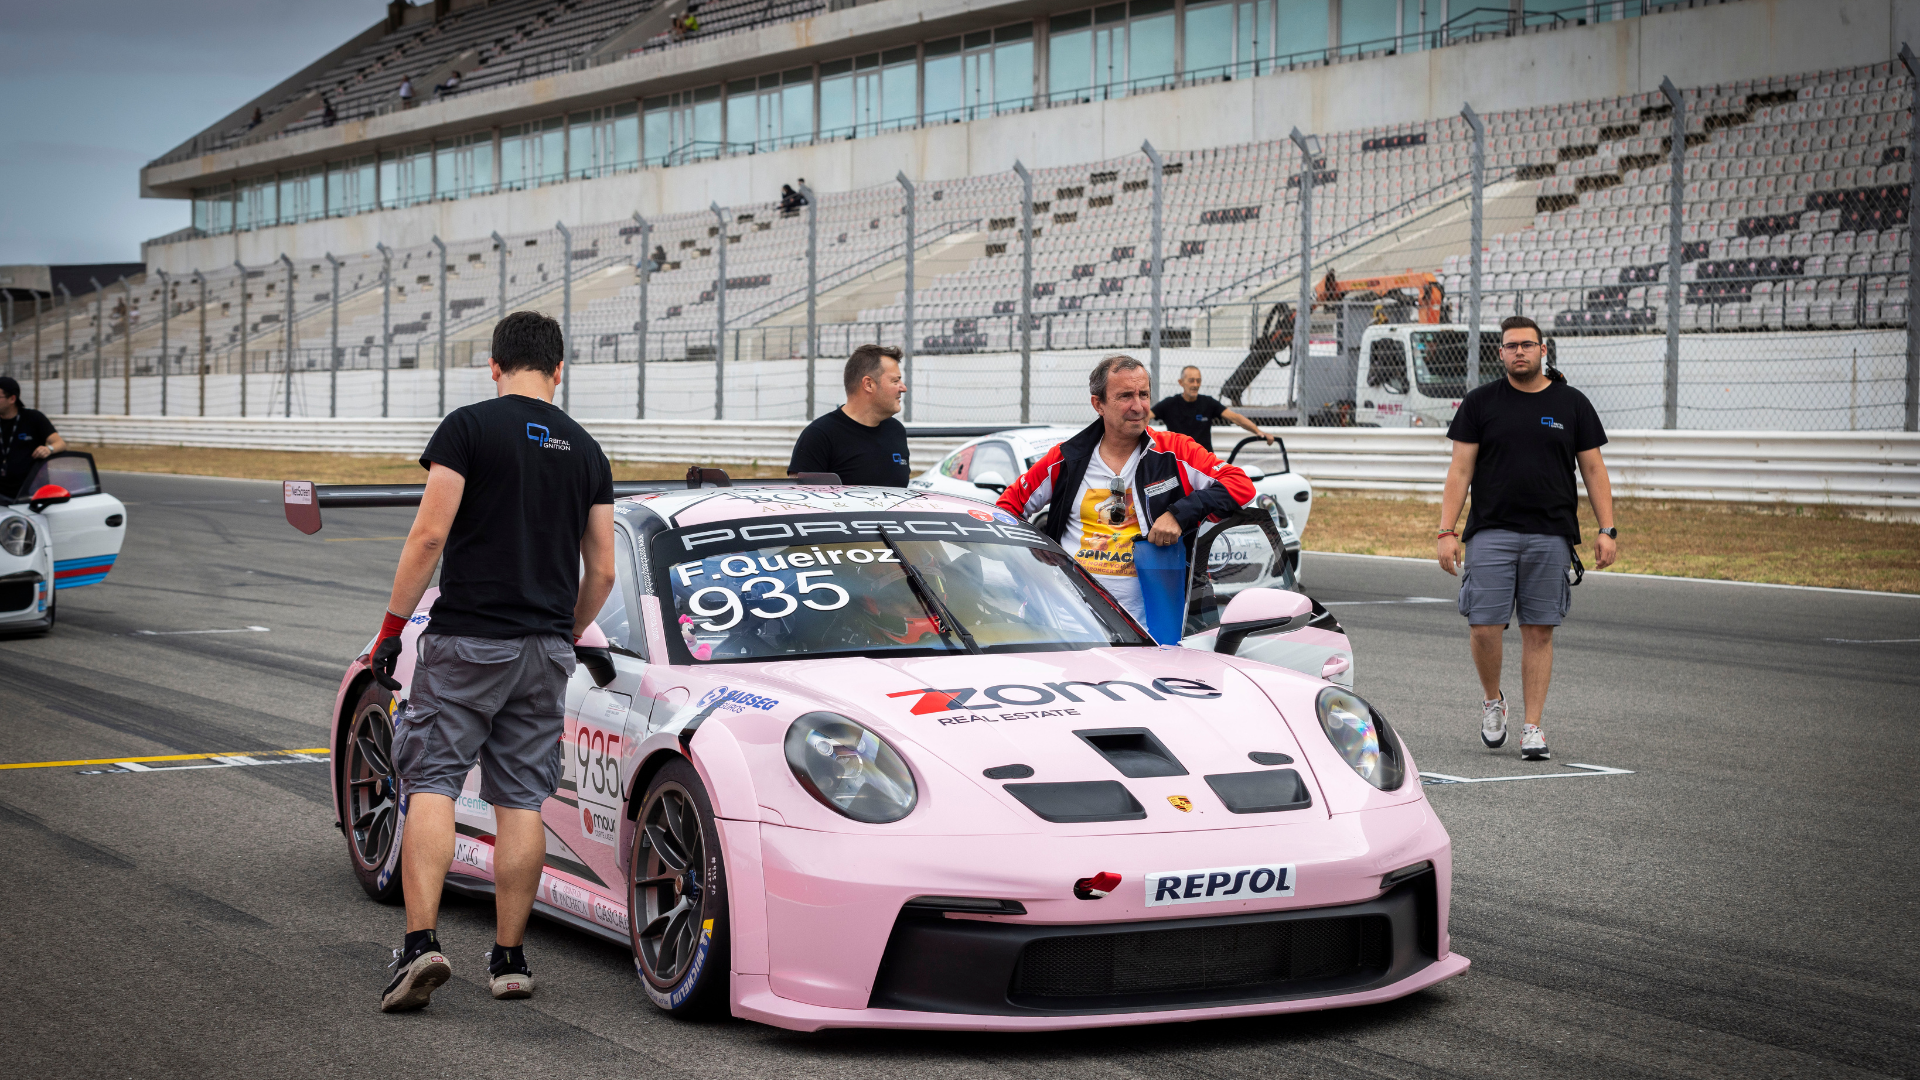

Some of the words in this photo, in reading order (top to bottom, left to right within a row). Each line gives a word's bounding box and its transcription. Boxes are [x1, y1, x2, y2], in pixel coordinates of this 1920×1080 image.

[681, 520, 1049, 551] PORSCHE
[676, 546, 901, 587] F.Queiroz
[688, 570, 850, 632] 935
[721, 690, 779, 711] SABSEG
[937, 715, 998, 727] REAL
[1002, 708, 1081, 722] ESTATE
[577, 726, 620, 798] 935
[1154, 867, 1292, 902] REPSOL
[672, 947, 705, 1005] MICHELIN
